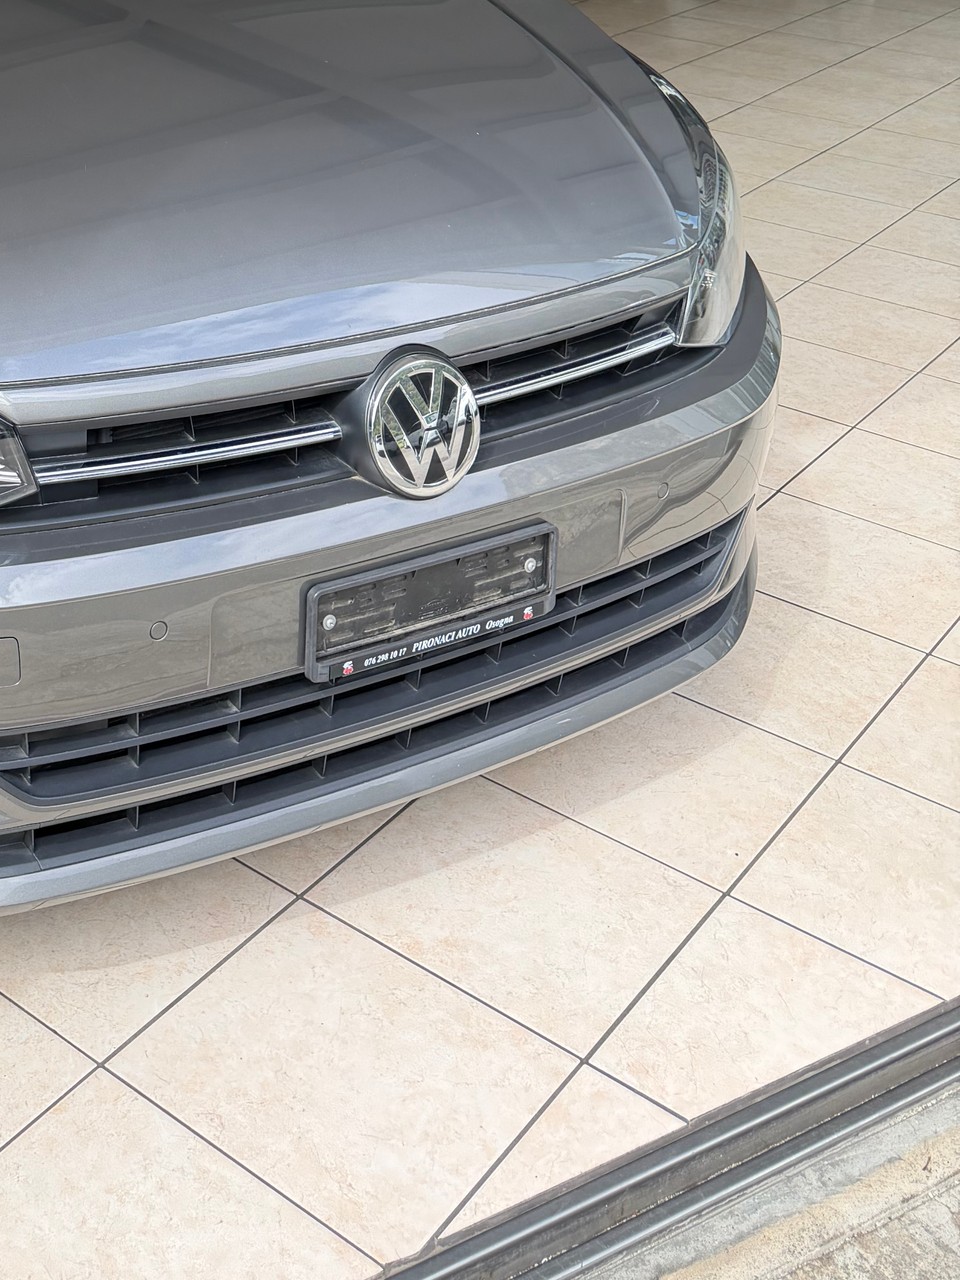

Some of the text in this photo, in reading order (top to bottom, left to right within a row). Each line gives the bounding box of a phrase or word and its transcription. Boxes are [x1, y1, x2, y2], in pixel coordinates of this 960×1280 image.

[363, 656, 377, 667] 076
[390, 650, 398, 659] 10
[398, 647, 408, 657] 17
[411, 631, 456, 653] PIRONACI
[455, 623, 481, 640] AUTO
[485, 615, 514, 630] Osogna
